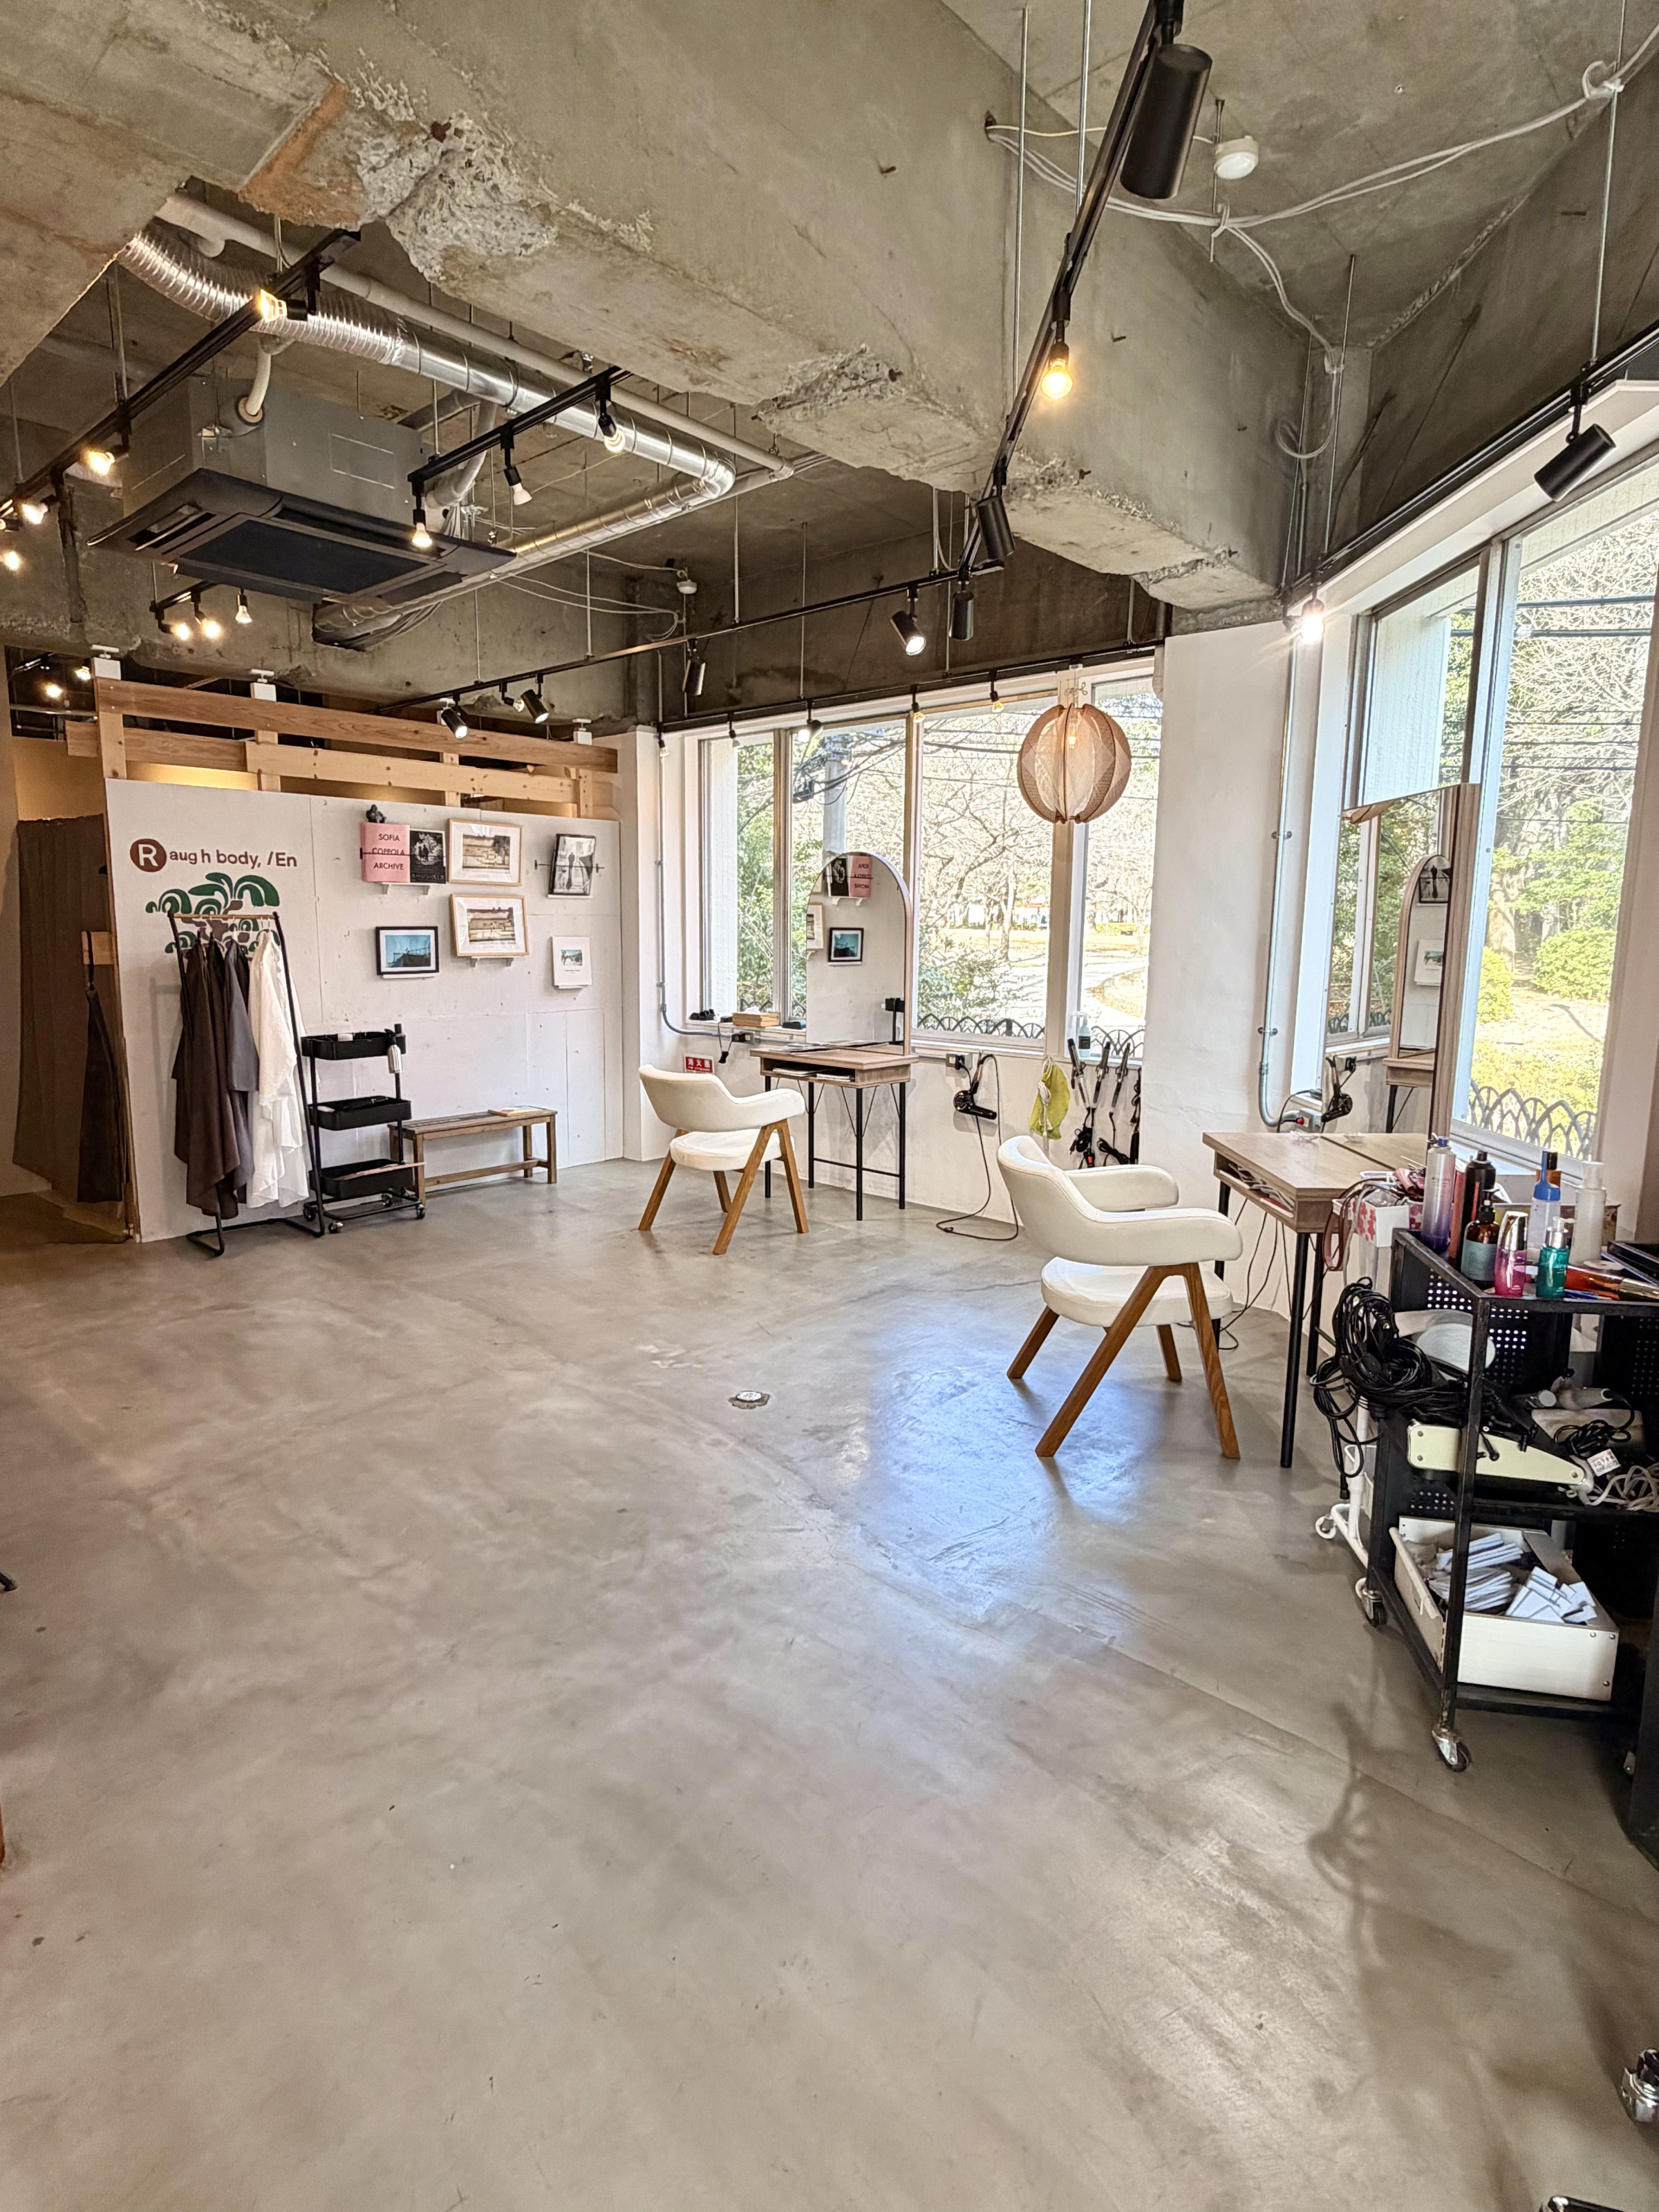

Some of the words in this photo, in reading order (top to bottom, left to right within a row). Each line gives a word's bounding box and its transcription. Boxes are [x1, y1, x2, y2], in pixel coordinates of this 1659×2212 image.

[372, 847, 405, 856] COPPOLA
[216, 850, 261, 869] body,
[373, 862, 404, 870] ARCHIVE
